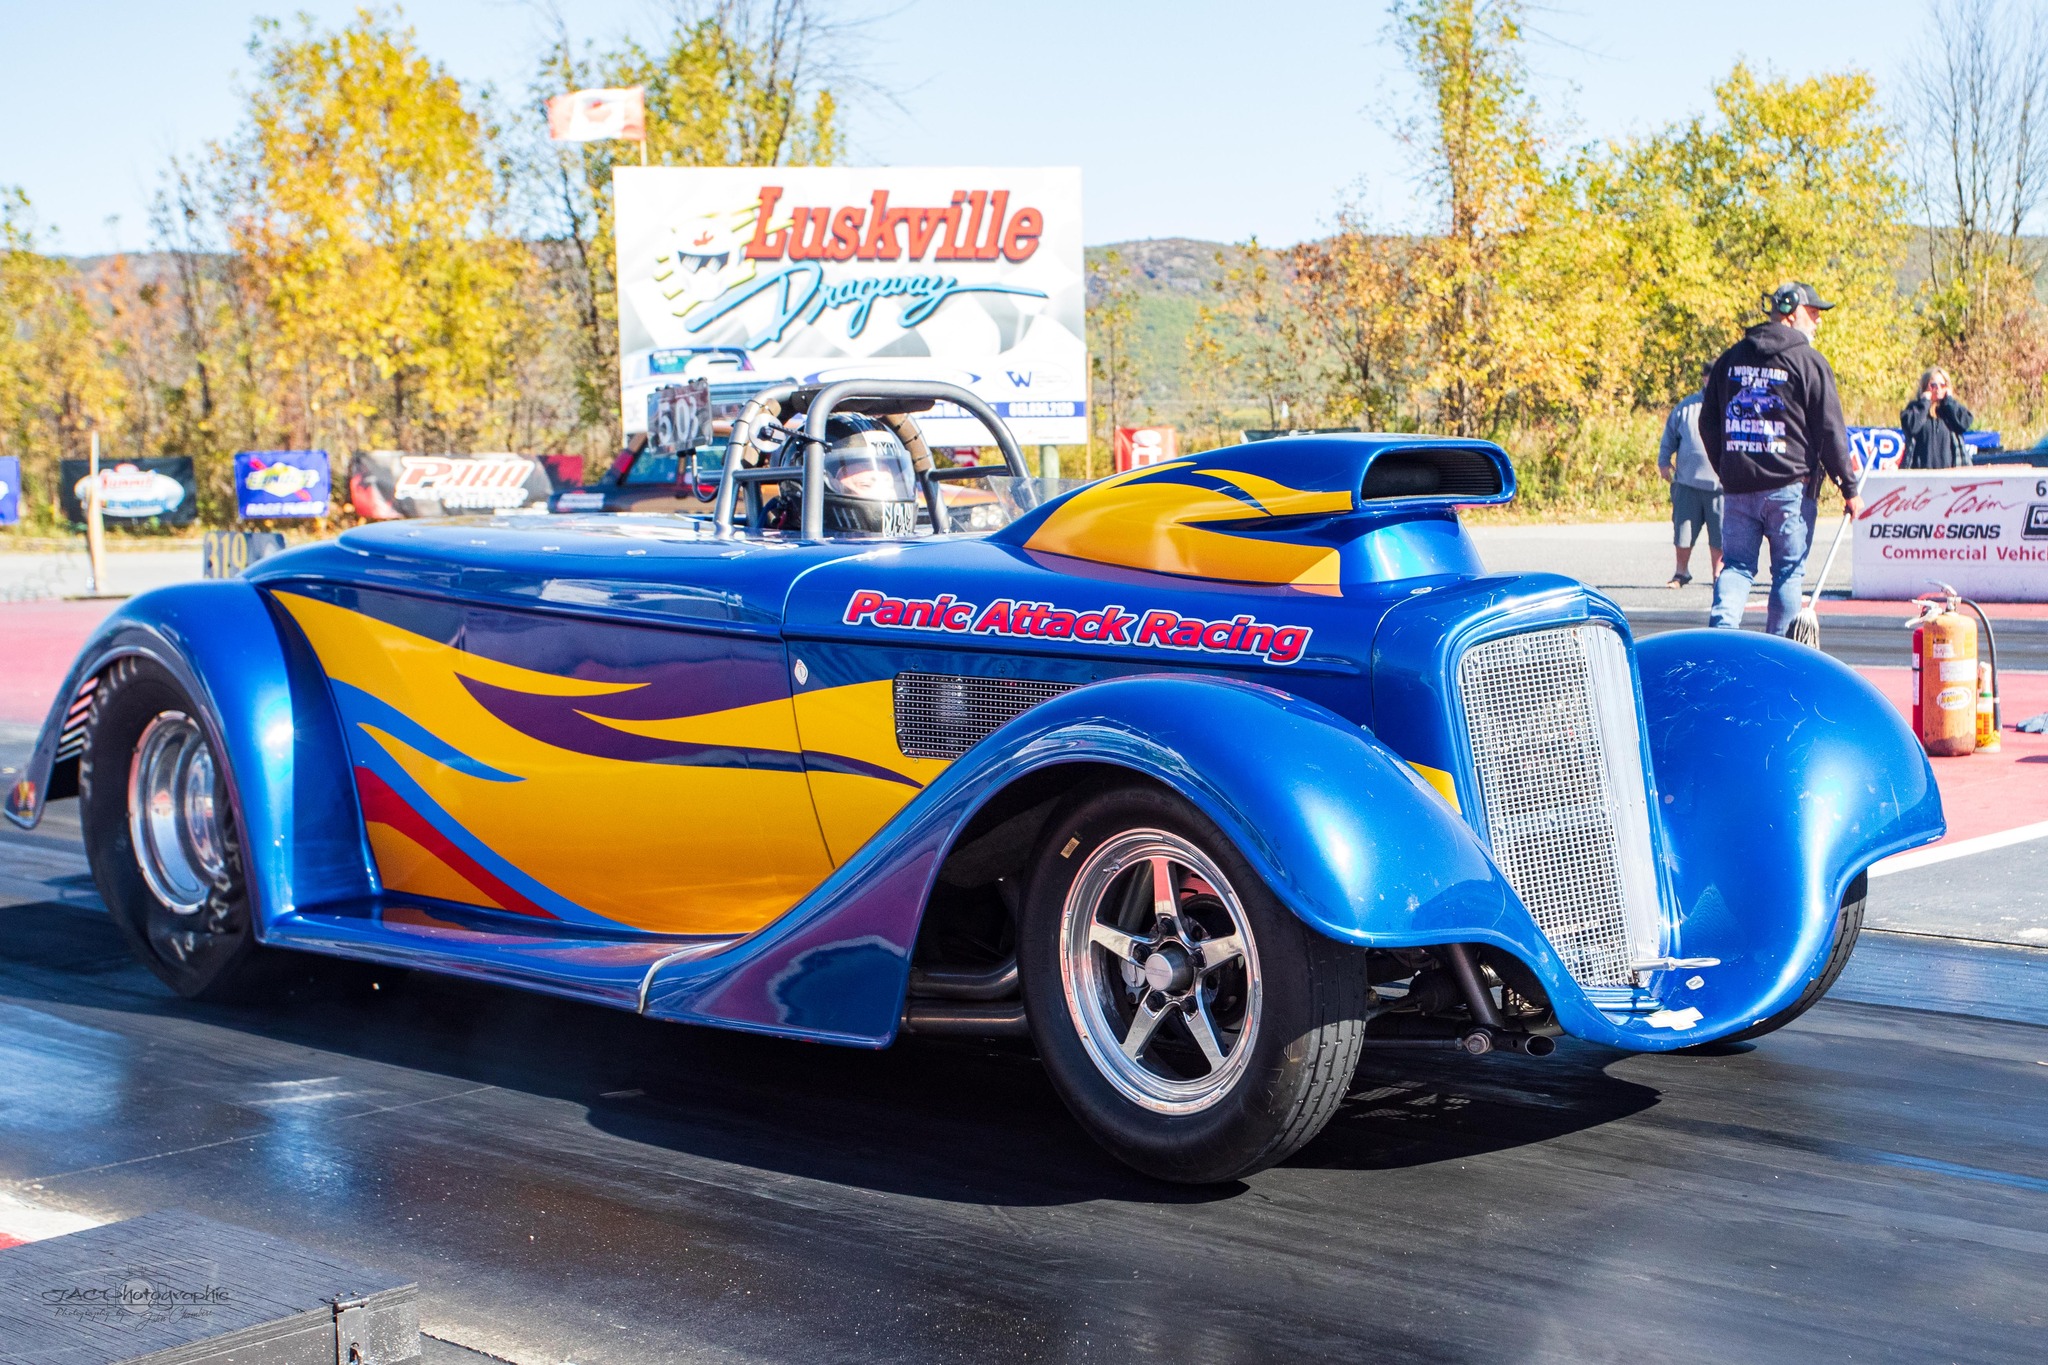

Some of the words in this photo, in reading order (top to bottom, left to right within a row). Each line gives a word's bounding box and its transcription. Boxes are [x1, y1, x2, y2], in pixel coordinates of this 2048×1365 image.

[745, 186, 1043, 263] Luskville
[685, 261, 1049, 351] Dragway
[1734, 365, 1760, 378] WORK
[1760, 367, 1789, 382] HARD
[1754, 378, 1769, 389] MY
[1858, 485, 1948, 520] Auto
[1944, 480, 2026, 518] Trim
[1882, 544, 1987, 561] Commercial
[843, 588, 978, 632] Panic
[974, 598, 1138, 644] Attack
[1137, 607, 1315, 666] Racing
